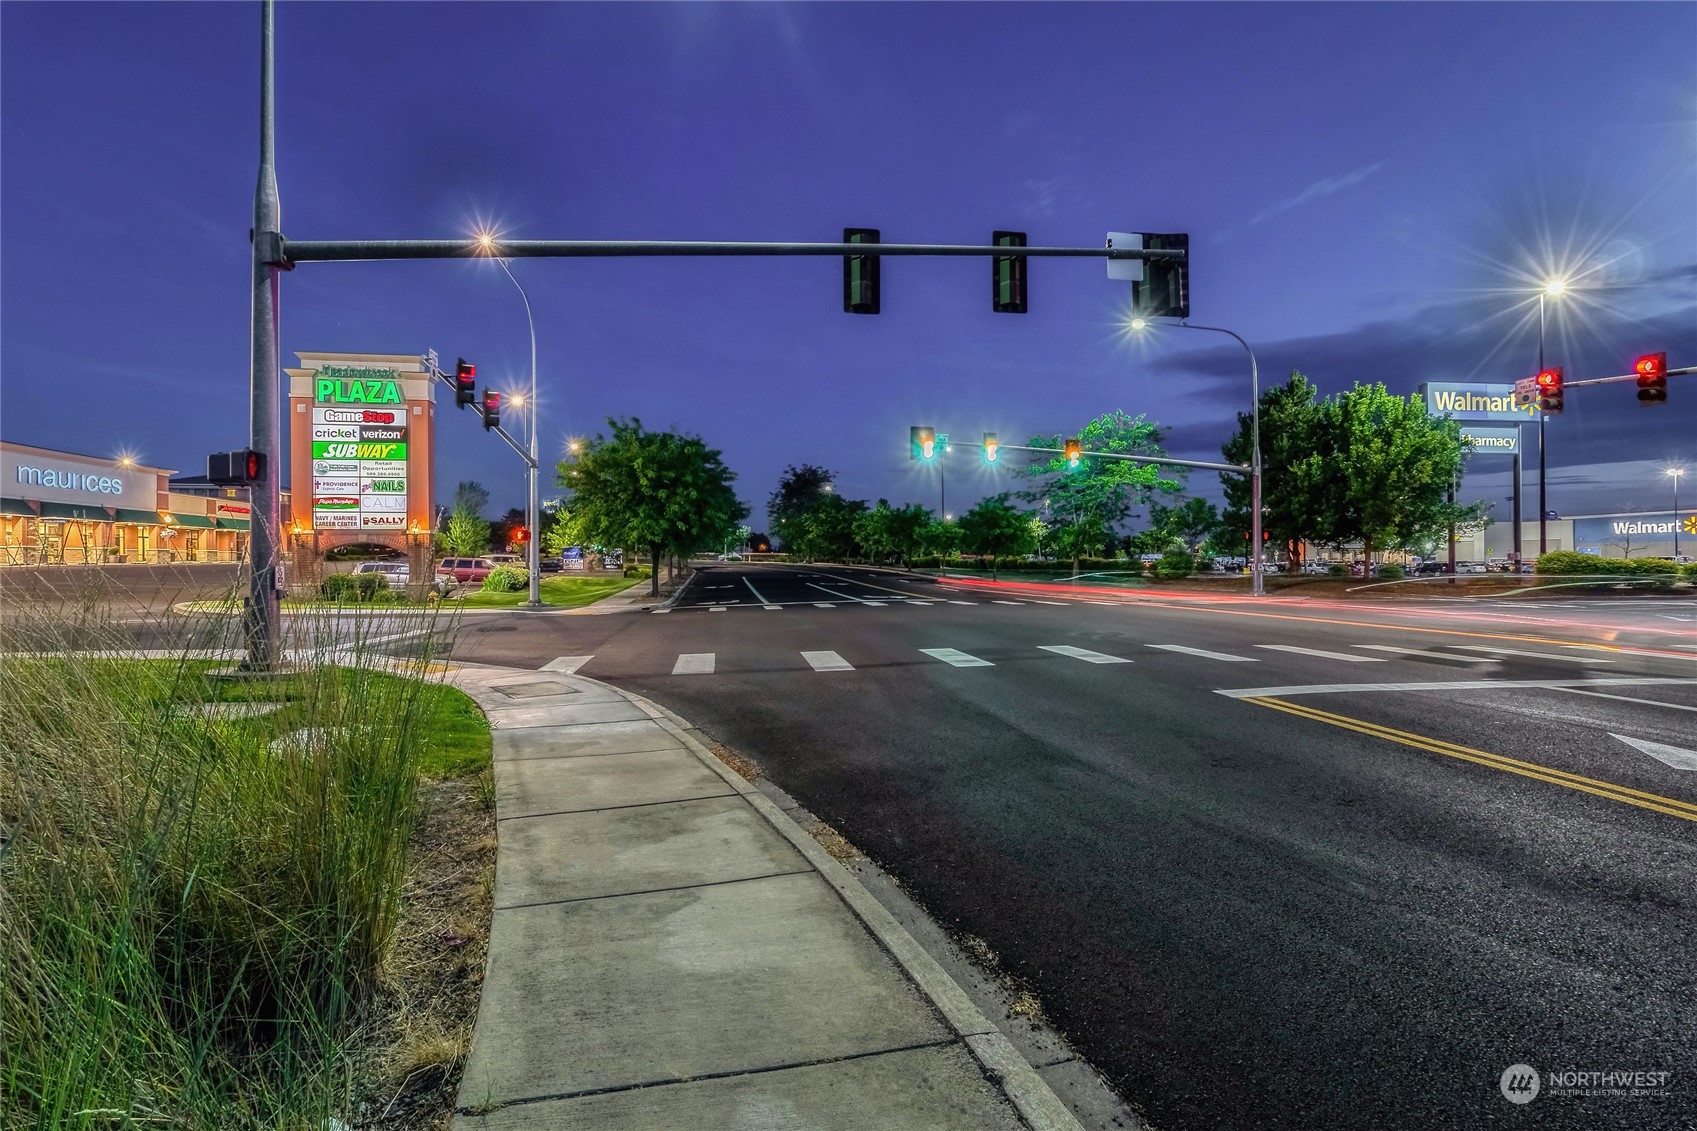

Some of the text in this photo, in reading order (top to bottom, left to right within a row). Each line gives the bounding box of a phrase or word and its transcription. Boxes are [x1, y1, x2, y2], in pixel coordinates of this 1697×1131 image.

[317, 379, 401, 404] PLAZA
[1434, 391, 1517, 412] Walmart
[324, 409, 395, 424] GameStop
[315, 428, 357, 438] cricket
[362, 430, 400, 439] verizon
[322, 443, 397, 458] SUBWAY
[17, 465, 122, 495] maurices
[372, 480, 405, 492] NAILS
[362, 497, 406, 507] CALM
[1613, 520, 1682, 535] Walmart
